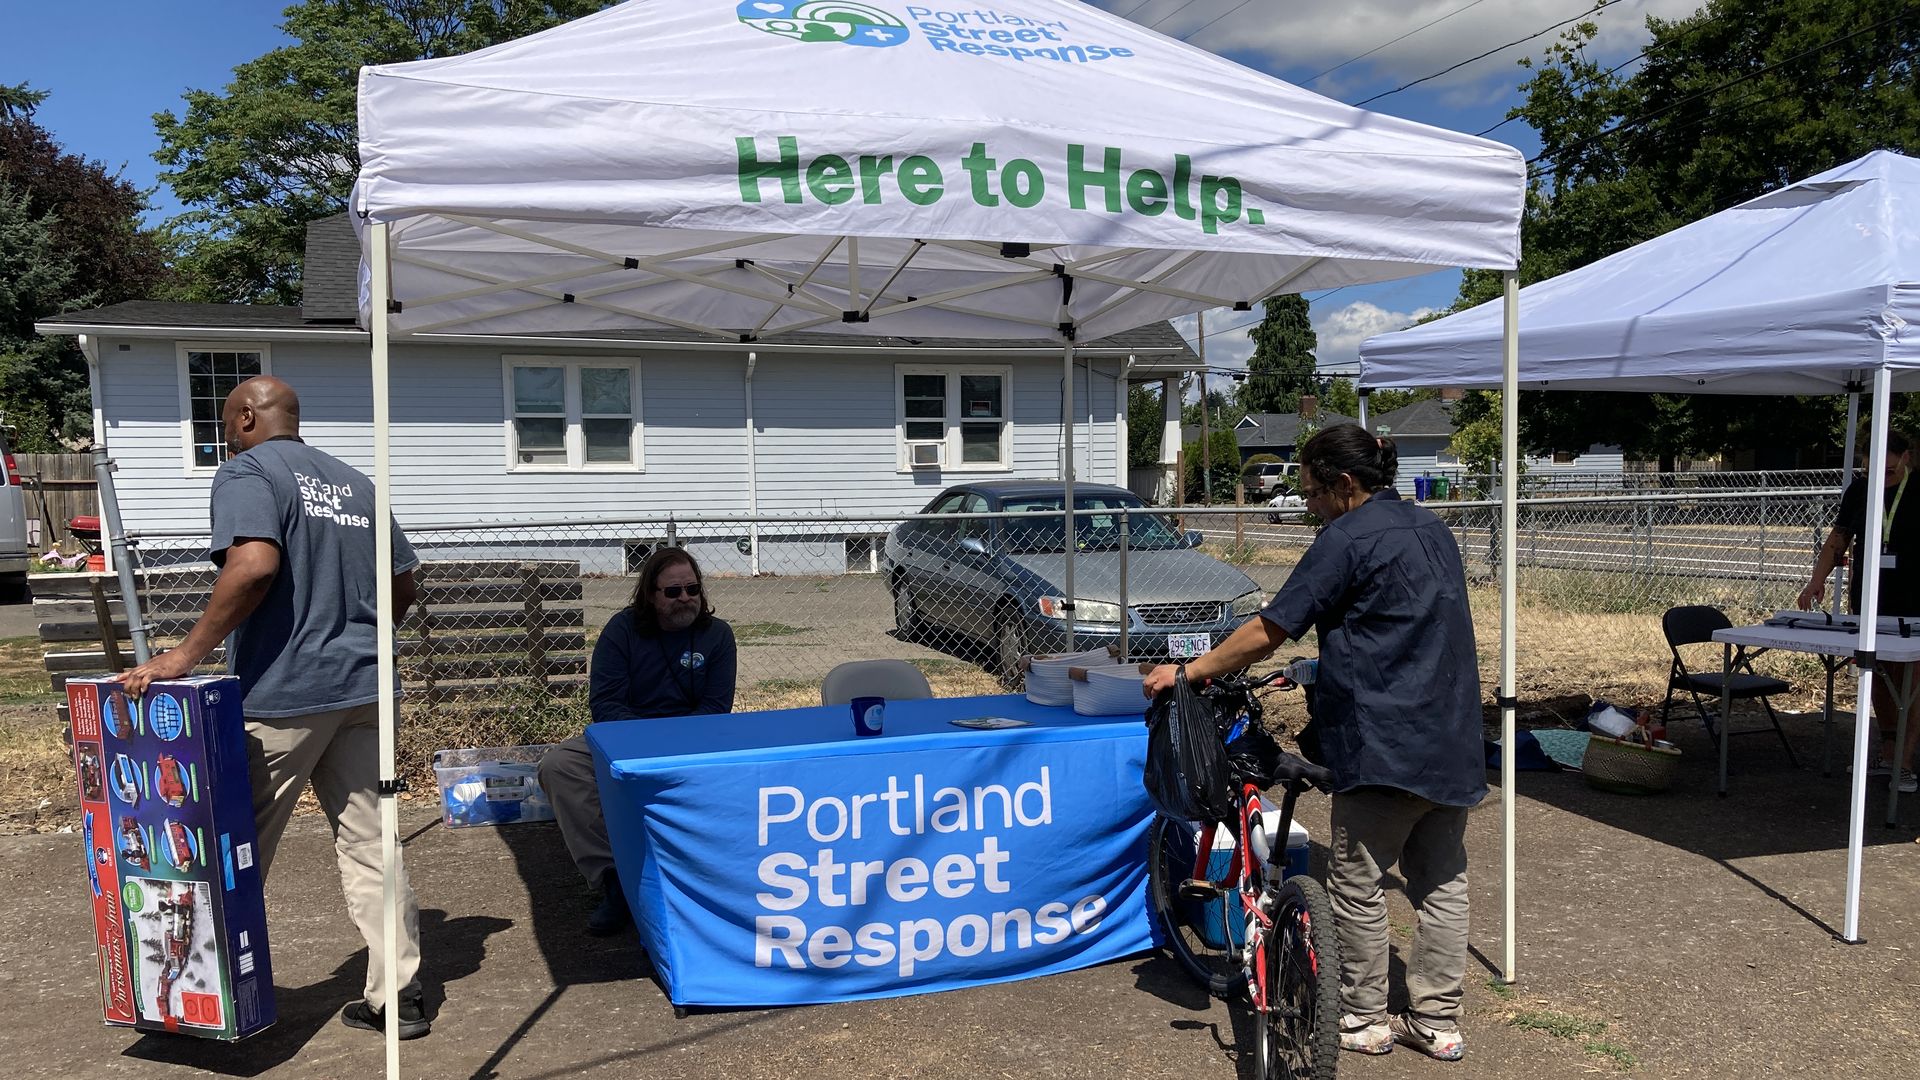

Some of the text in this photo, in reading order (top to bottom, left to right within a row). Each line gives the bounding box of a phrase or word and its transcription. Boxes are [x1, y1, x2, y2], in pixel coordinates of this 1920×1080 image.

[906, 6, 1069, 31] Portland
[918, 22, 1062, 43] Street
[926, 36, 1136, 63] Response
[735, 136, 1266, 235] Here to Help.
[294, 472, 353, 497] Porand
[303, 501, 370, 528] Resnse
[758, 766, 1053, 846] Portland
[755, 836, 1011, 911] Street
[105, 890, 123, 938] Train
[754, 894, 1108, 977] Response
[112, 936, 131, 1018] Christmas
